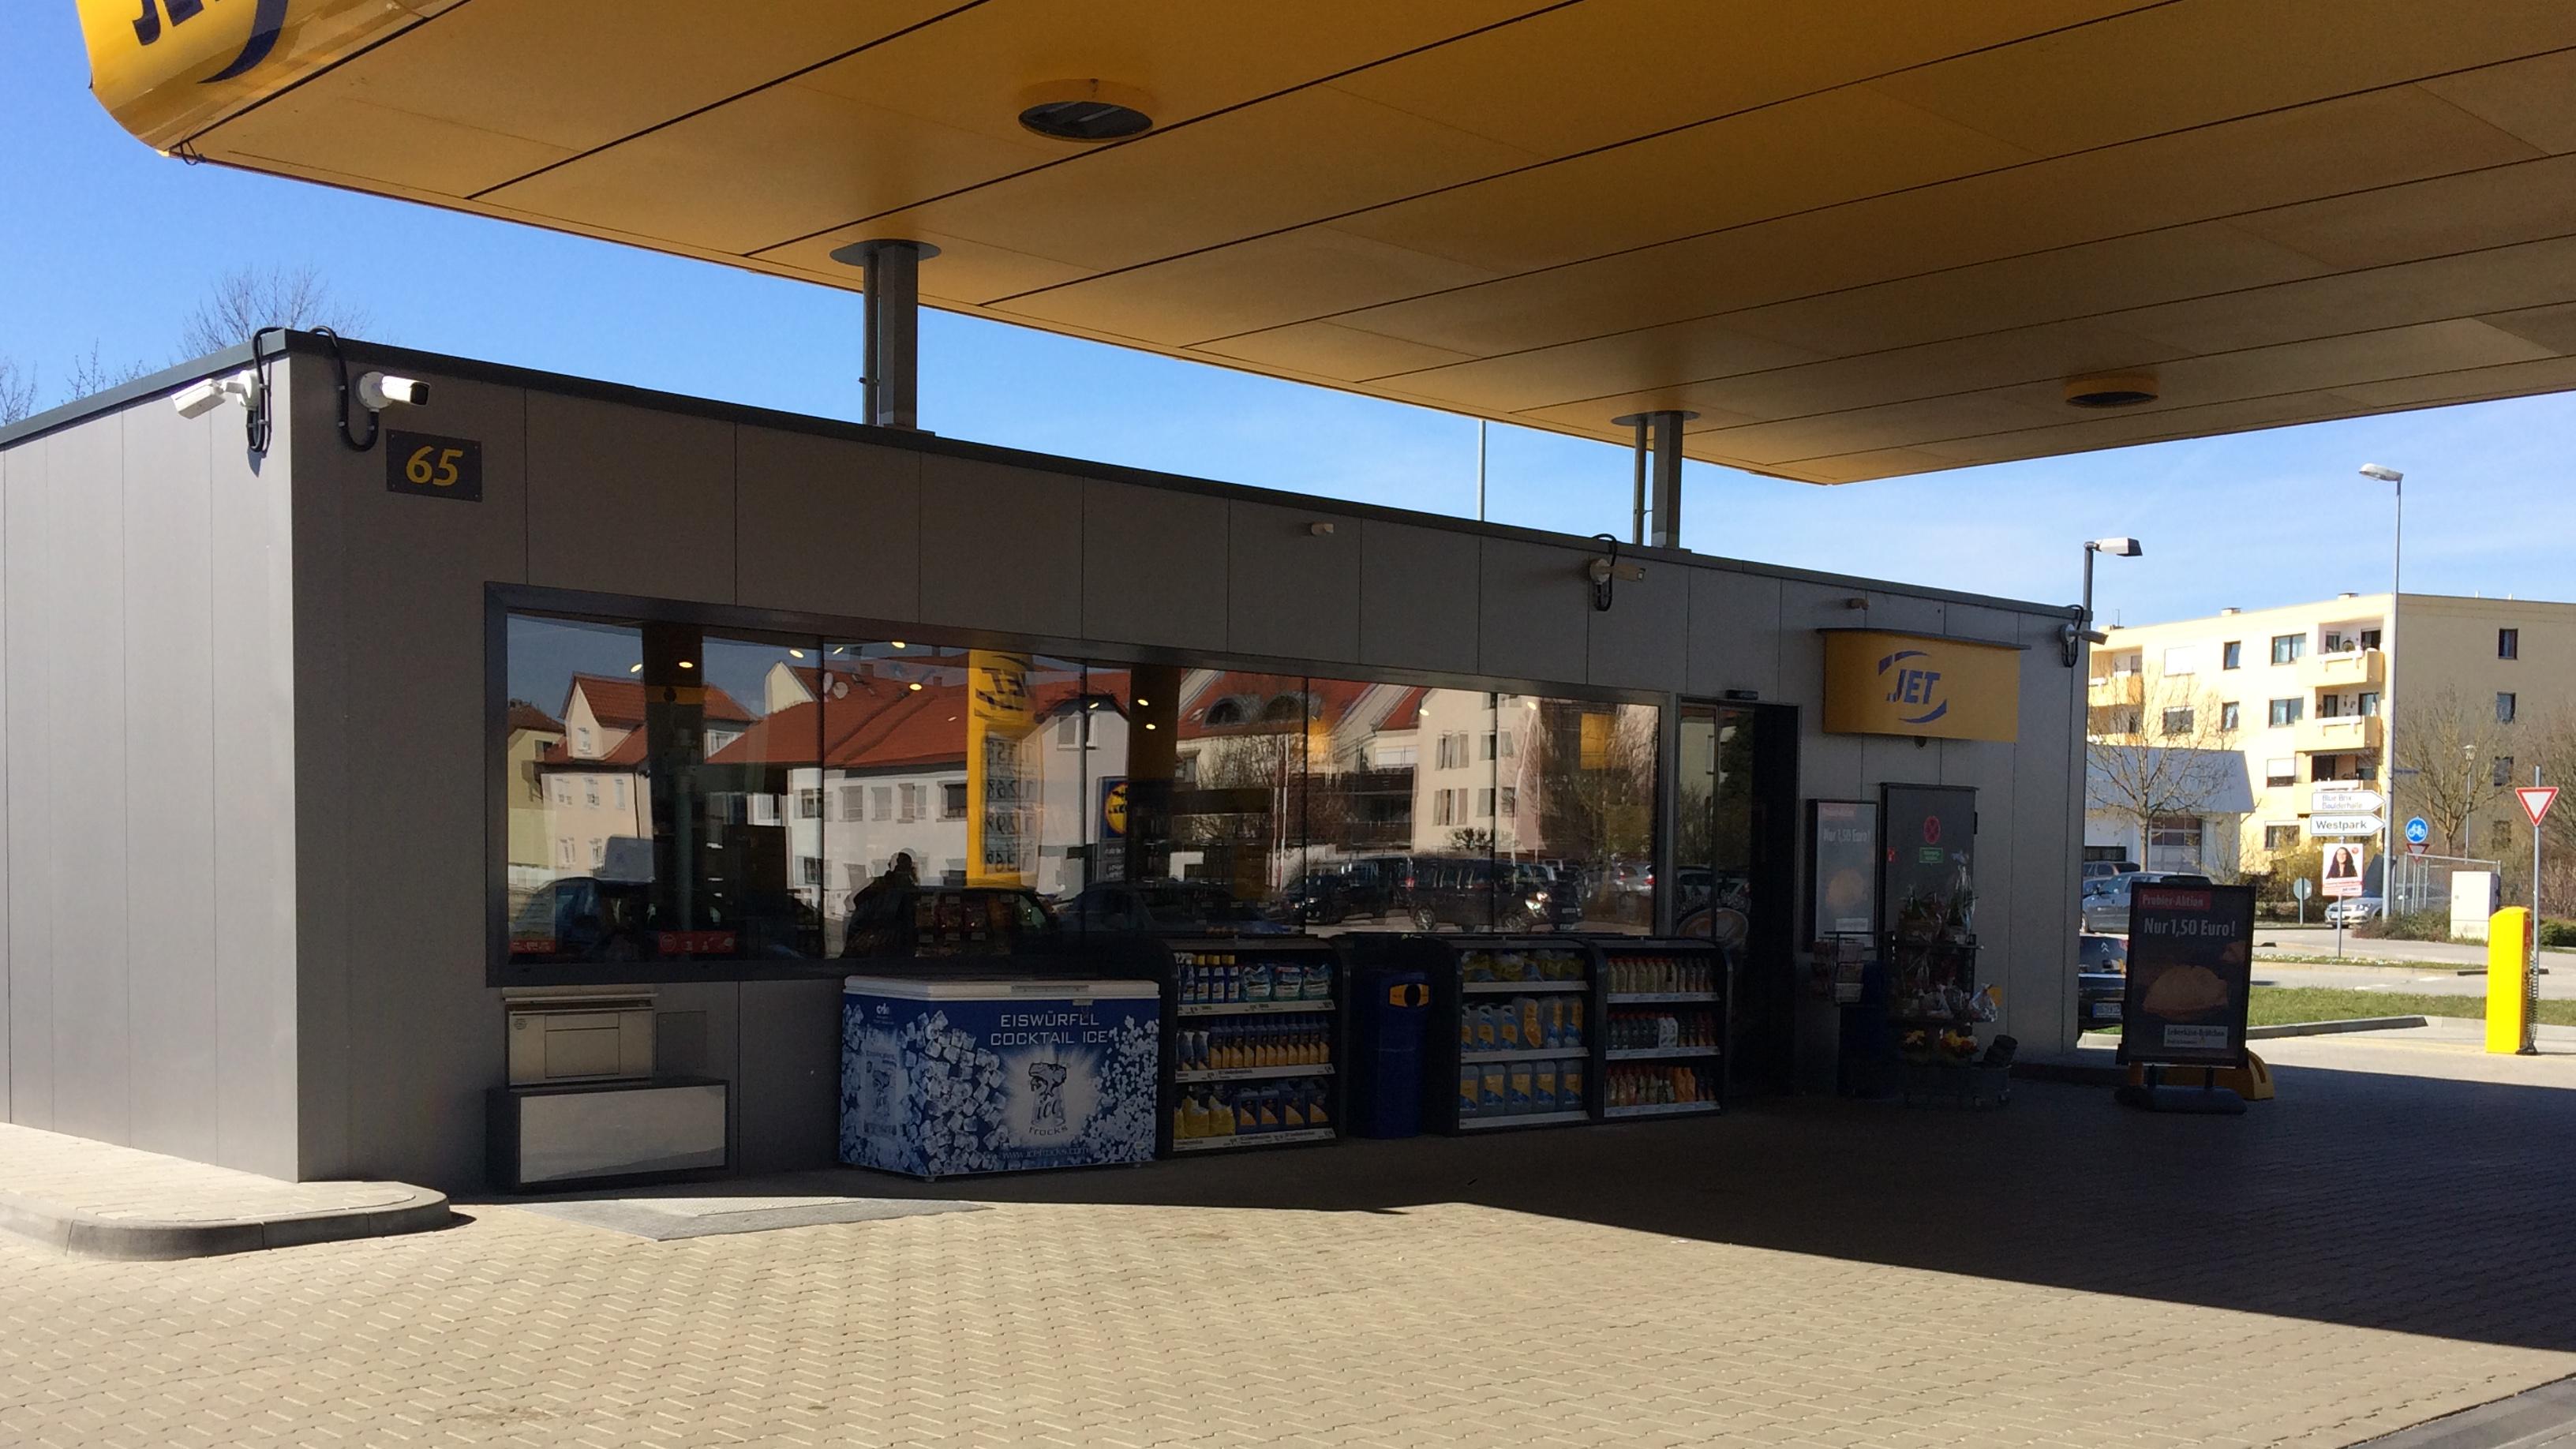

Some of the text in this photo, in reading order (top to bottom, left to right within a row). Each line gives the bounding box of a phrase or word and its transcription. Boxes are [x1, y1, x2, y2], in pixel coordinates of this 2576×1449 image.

[406, 445, 464, 487] 65
[1886, 668, 1941, 705] JET
[2316, 820, 2367, 831] Westpark
[2144, 917, 2169, 934] Nur
[2170, 919, 2198, 938] 1,50
[990, 1030, 1108, 1046] COCKTAIL ICE
